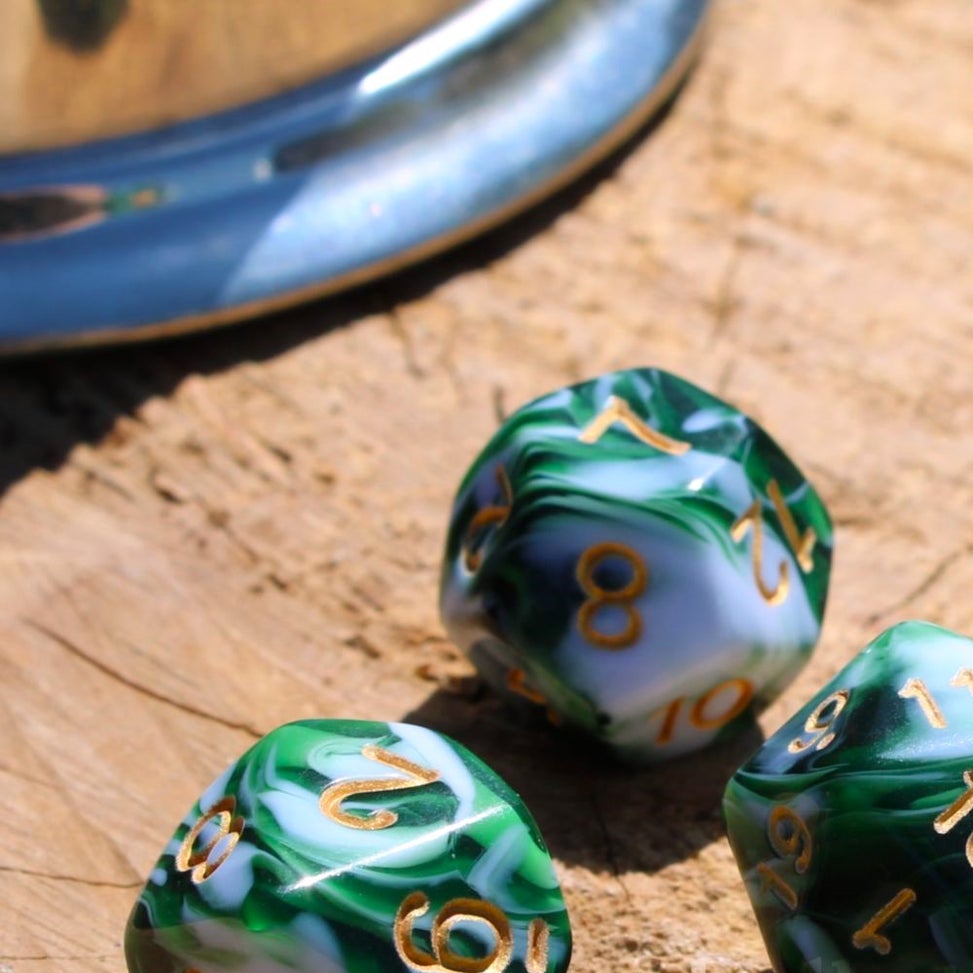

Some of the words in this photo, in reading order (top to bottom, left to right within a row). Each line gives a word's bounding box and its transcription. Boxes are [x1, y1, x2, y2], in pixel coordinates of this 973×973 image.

[576, 542, 648, 651] 8
[650, 678, 754, 744] 10
[175, 795, 246, 885] 8
